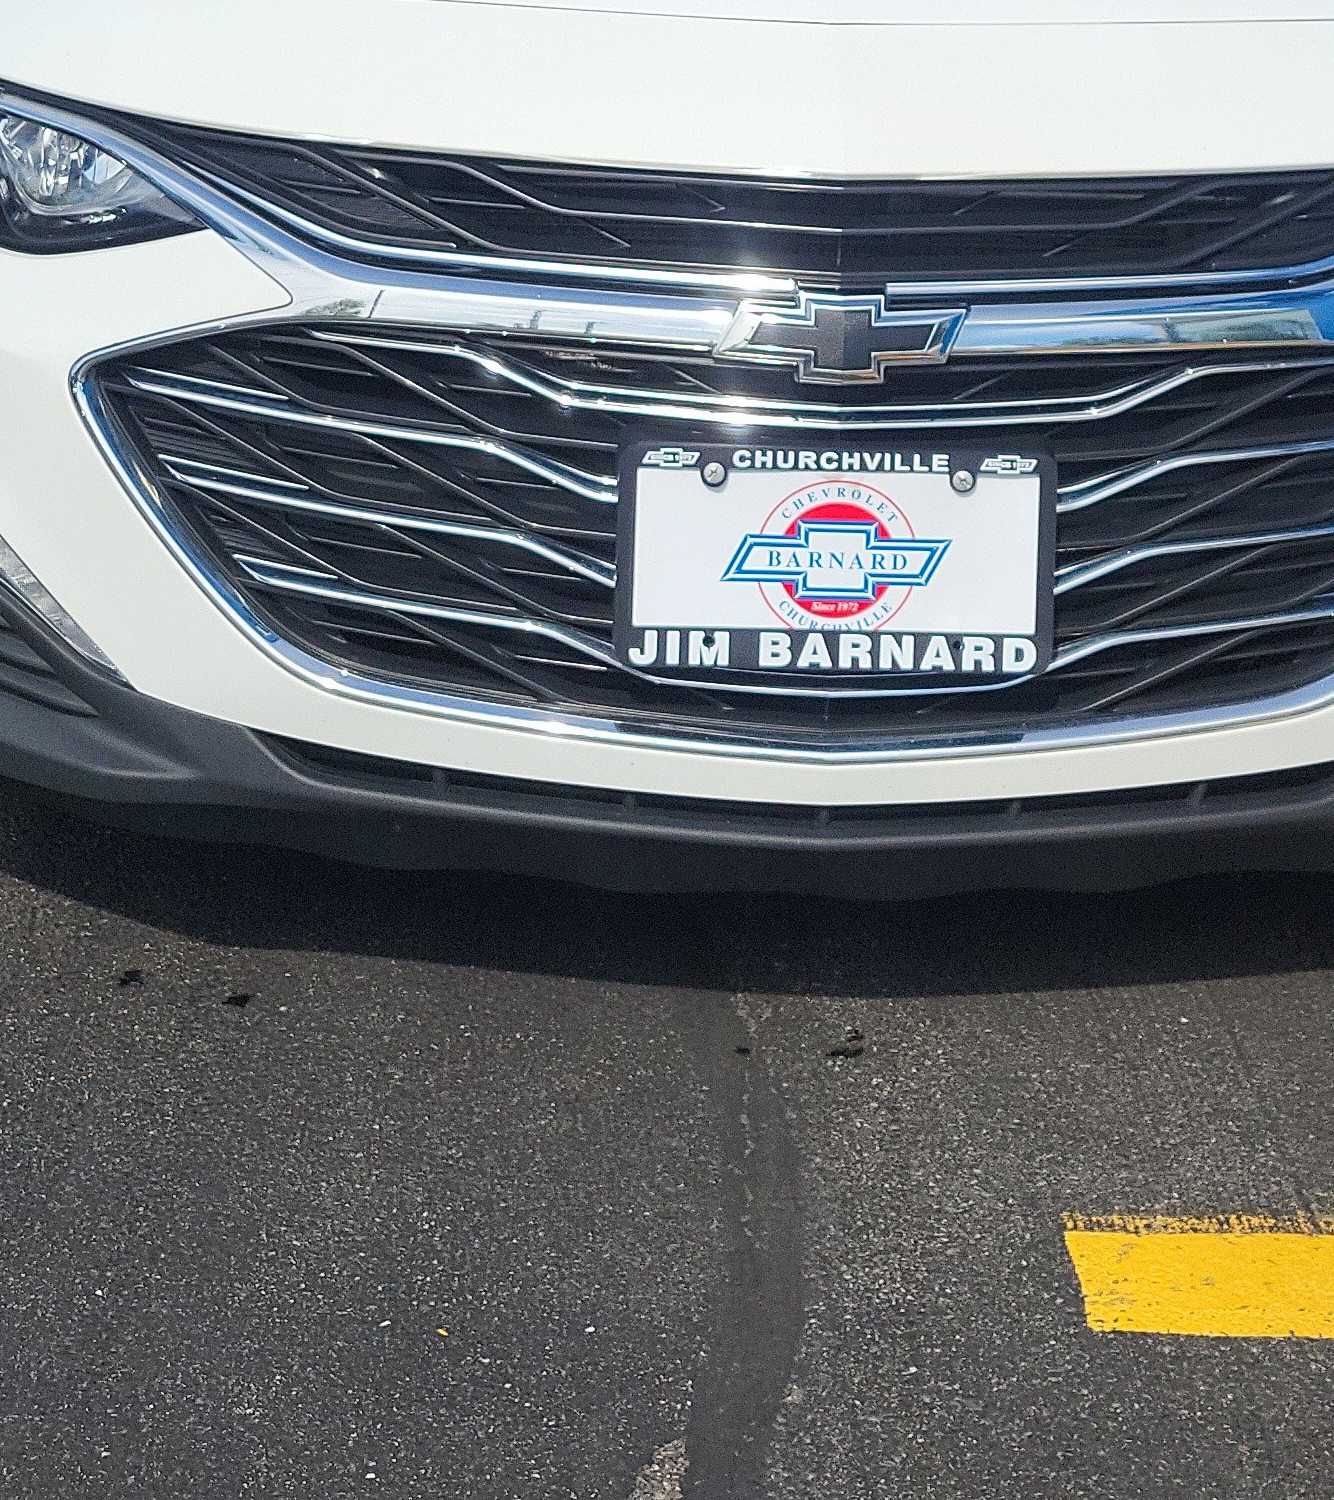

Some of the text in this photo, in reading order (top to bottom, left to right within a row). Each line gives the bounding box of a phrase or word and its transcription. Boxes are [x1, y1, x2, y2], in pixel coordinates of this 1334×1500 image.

[731, 449, 951, 473] CHURCHVILLE
[781, 487, 898, 523] CHEVROLET
[767, 549, 908, 570] BARNARD
[810, 601, 835, 612] Since
[627, 629, 1038, 673] JIM BARNARD
